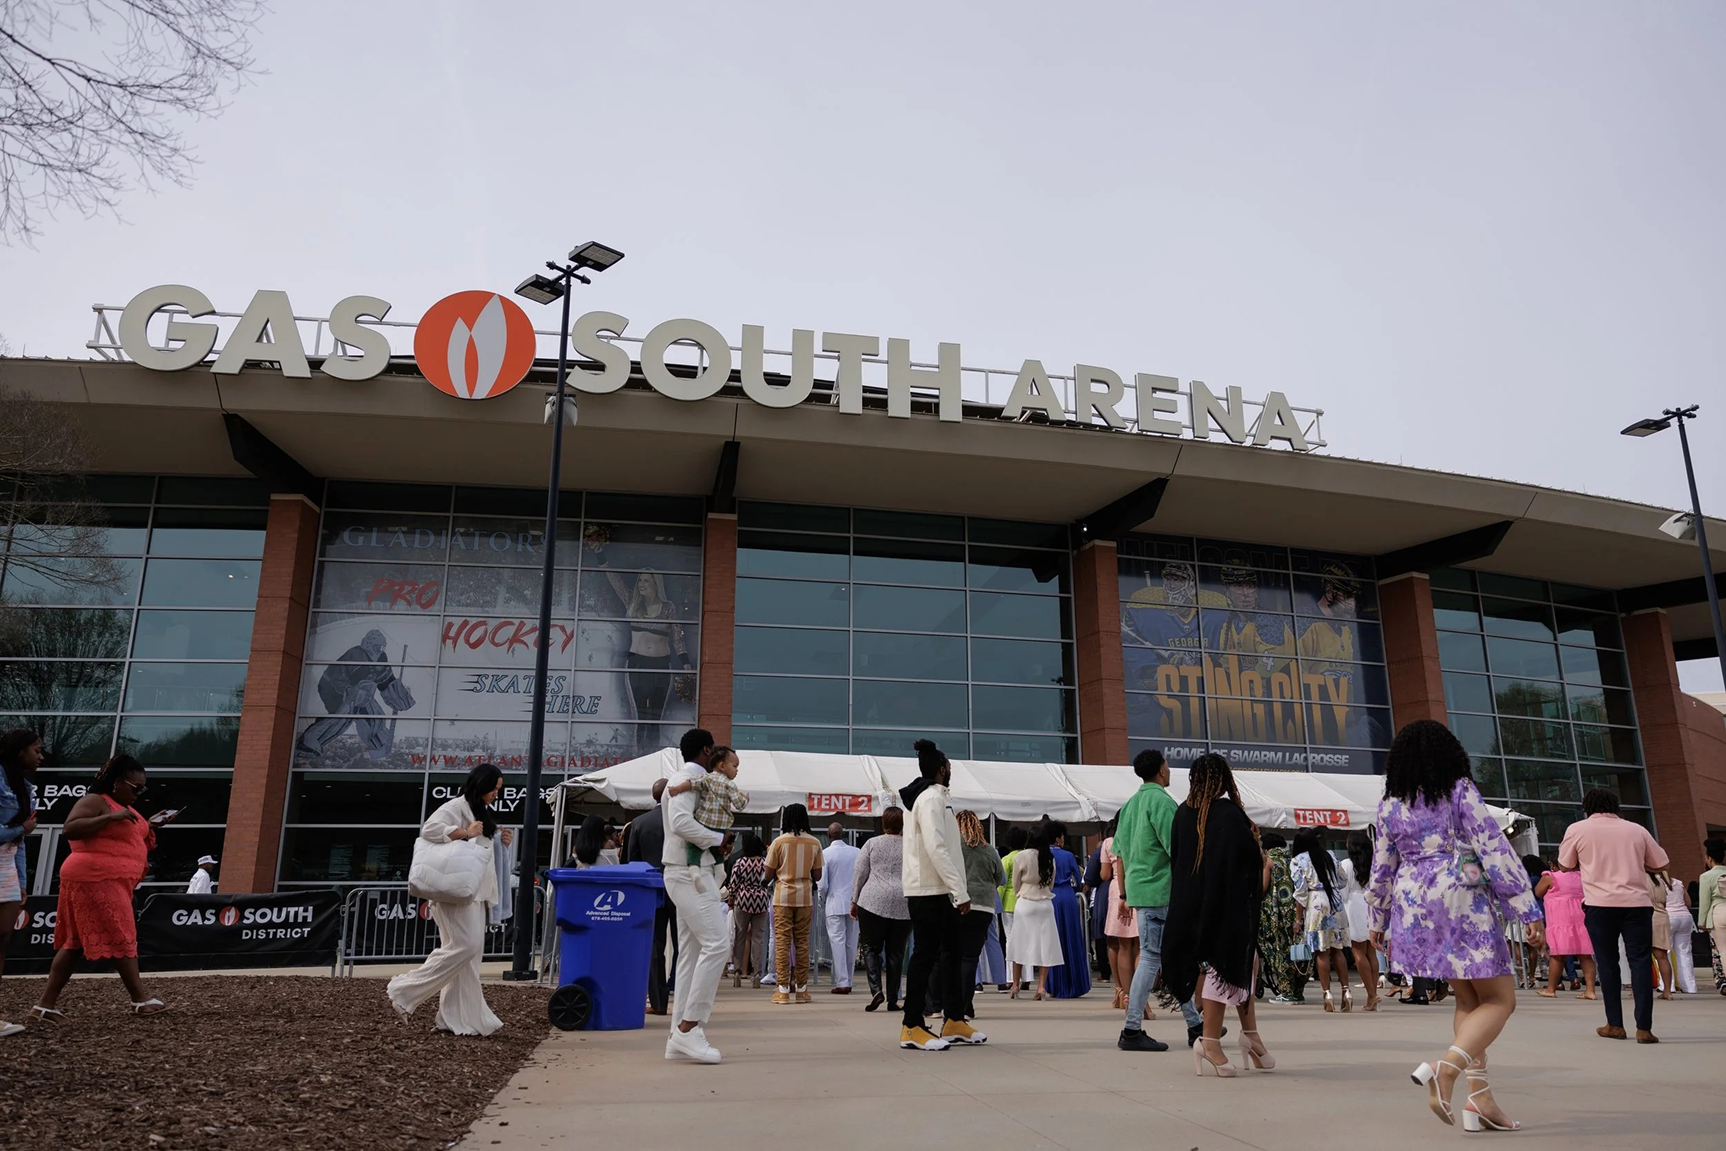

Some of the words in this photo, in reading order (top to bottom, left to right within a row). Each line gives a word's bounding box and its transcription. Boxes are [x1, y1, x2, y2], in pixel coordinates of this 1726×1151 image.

[118, 284, 392, 381] GAS
[565, 311, 961, 423] SOUTH
[1000, 359, 1308, 452] ARENA
[367, 576, 441, 611] PRO
[1156, 651, 1265, 742] STING
[1271, 658, 1350, 747] CITY
[1229, 749, 1282, 764] SWARM
[1285, 751, 1350, 767] LACROSSE
[811, 794, 852, 810] TENT
[857, 796, 869, 810] 2
[1296, 810, 1332, 824] TENT
[1336, 811, 1347, 824] 2
[171, 908, 217, 926] GAS
[242, 906, 313, 925] SOUTH
[374, 903, 417, 920] GAS
[242, 927, 311, 940] DISTRICT
